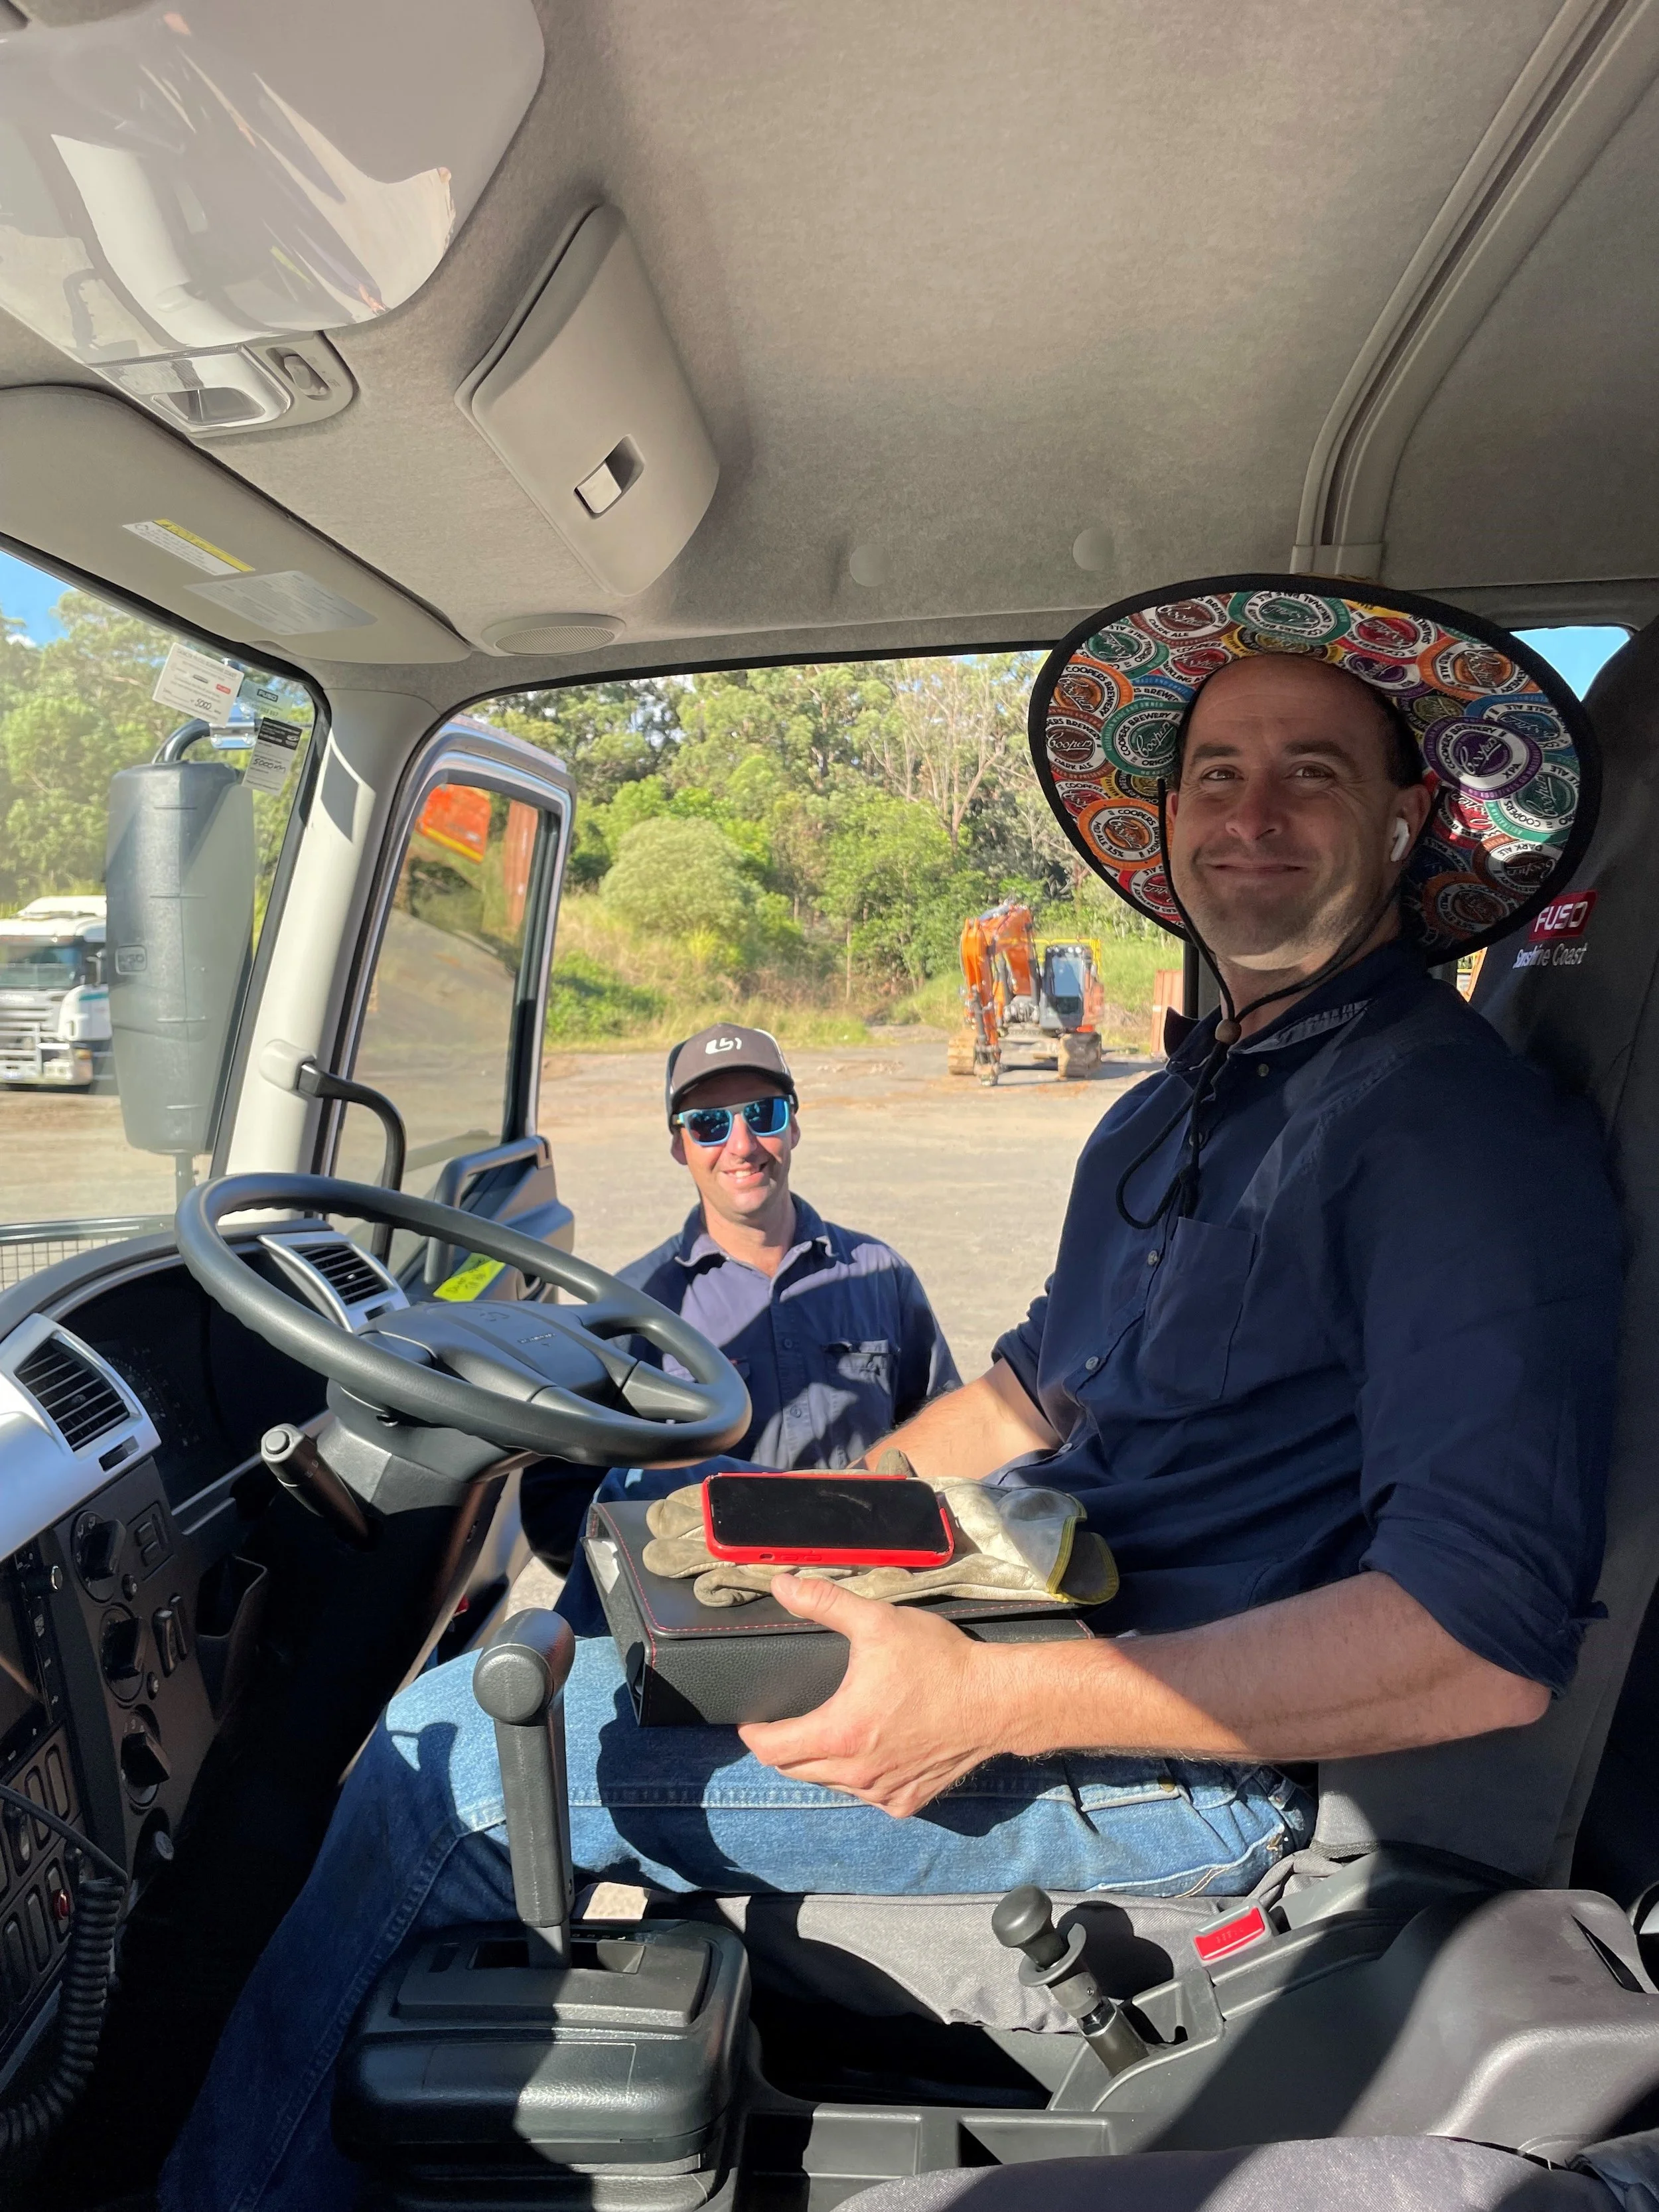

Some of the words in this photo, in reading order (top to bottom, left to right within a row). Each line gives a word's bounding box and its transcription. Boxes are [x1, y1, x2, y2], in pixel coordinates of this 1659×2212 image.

[1149, 619, 1171, 635] DARK
[1065, 666, 1107, 682] COOPERS
[1099, 682, 1116, 717] BREWERY
[1066, 719, 1101, 741] BREWERY
[1118, 725, 1131, 757] COOPERS
[1127, 711, 1171, 726] BREWERY
[1046, 731, 1093, 753] Coopers
[1440, 734, 1455, 770] COOPERS
[1053, 757, 1076, 770] DARK
[1079, 762, 1094, 771] ALE
[1502, 763, 1522, 779] XPA
[1550, 765, 1569, 776] ALE
[1118, 808, 1157, 827] COOPERS
[1504, 800, 1542, 828] COOPERS
[1096, 834, 1108, 847] ALE
[1106, 846, 1124, 858] 3.5%
[1496, 846, 1512, 857] ALE
[1514, 844, 1543, 852] DARK
[1142, 866, 1157, 876] ALE
[1534, 901, 1589, 933] FUSO
[1512, 944, 1551, 970] Sunshine
[1552, 942, 1589, 967] Coast
